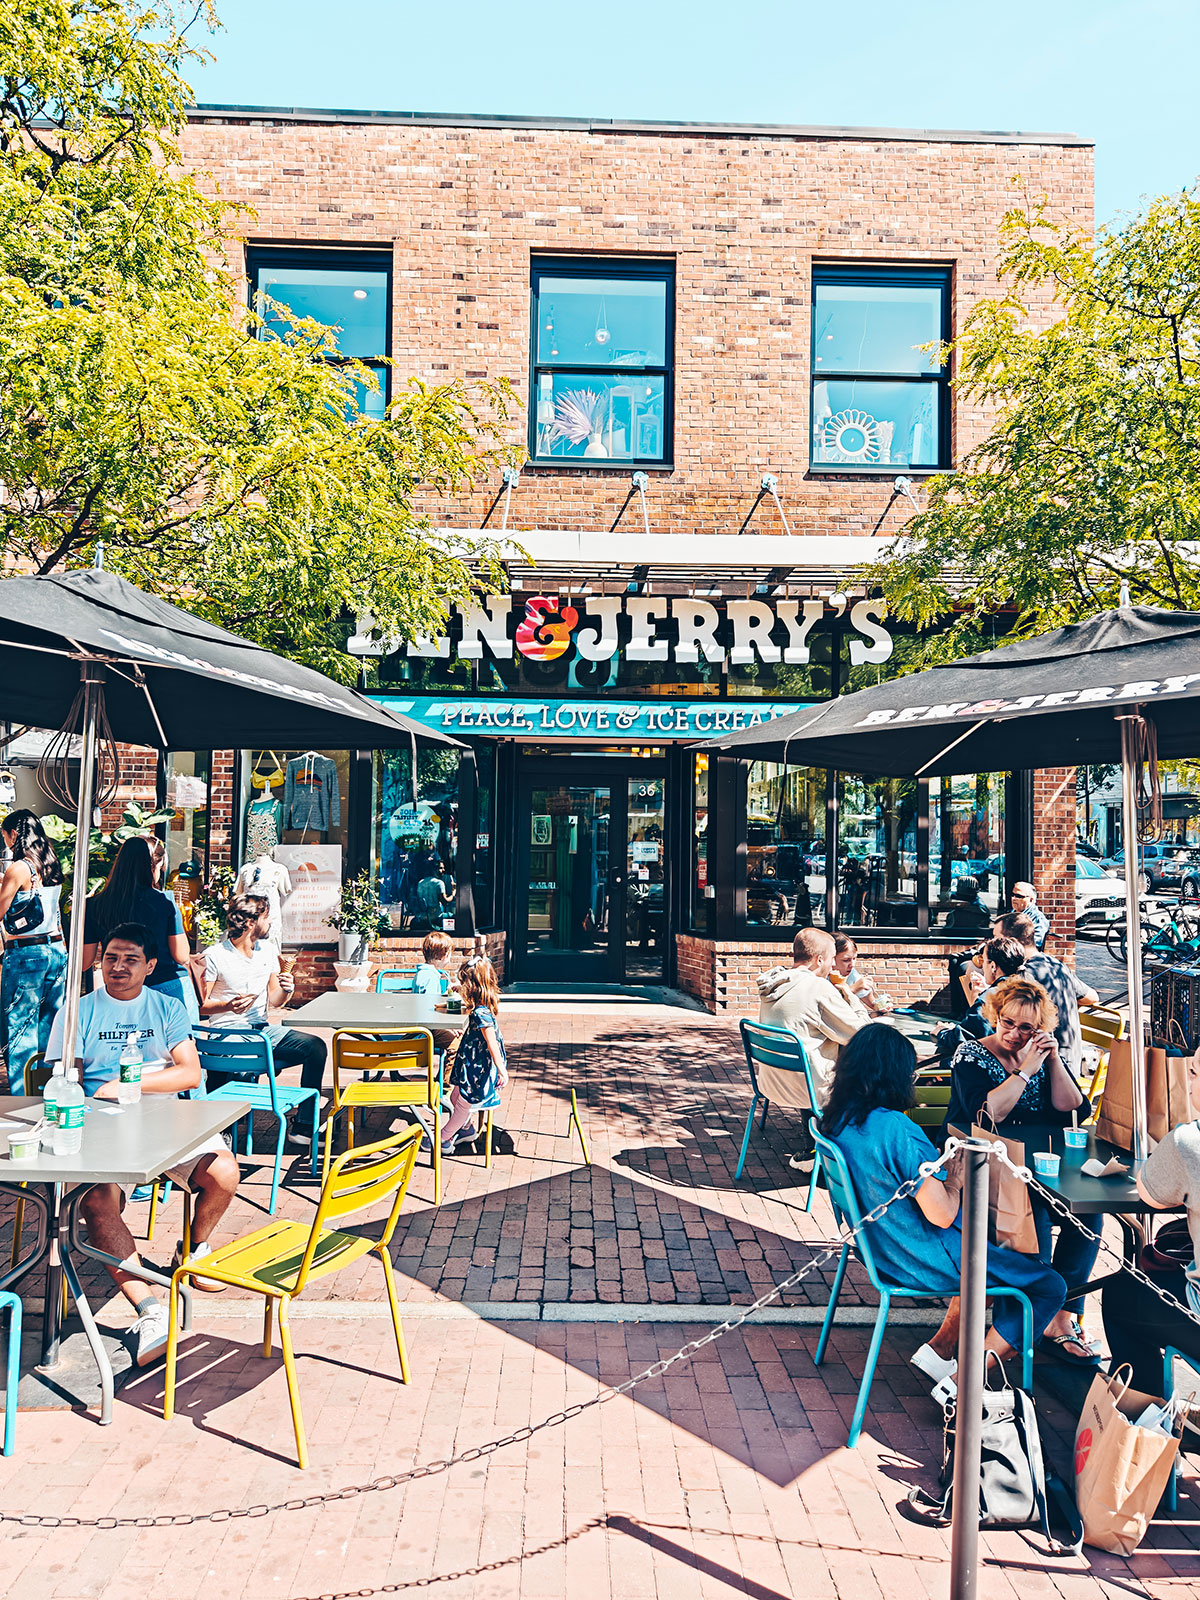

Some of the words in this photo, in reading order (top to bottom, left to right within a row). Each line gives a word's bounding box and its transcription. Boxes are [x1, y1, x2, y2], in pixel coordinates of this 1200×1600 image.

[577, 591, 894, 666] JERRY'S
[441, 703, 534, 731] PEACE,
[540, 705, 610, 729] LOVE
[615, 706, 640, 729] &
[646, 707, 689, 731] ICE
[638, 785, 655, 797] 36
